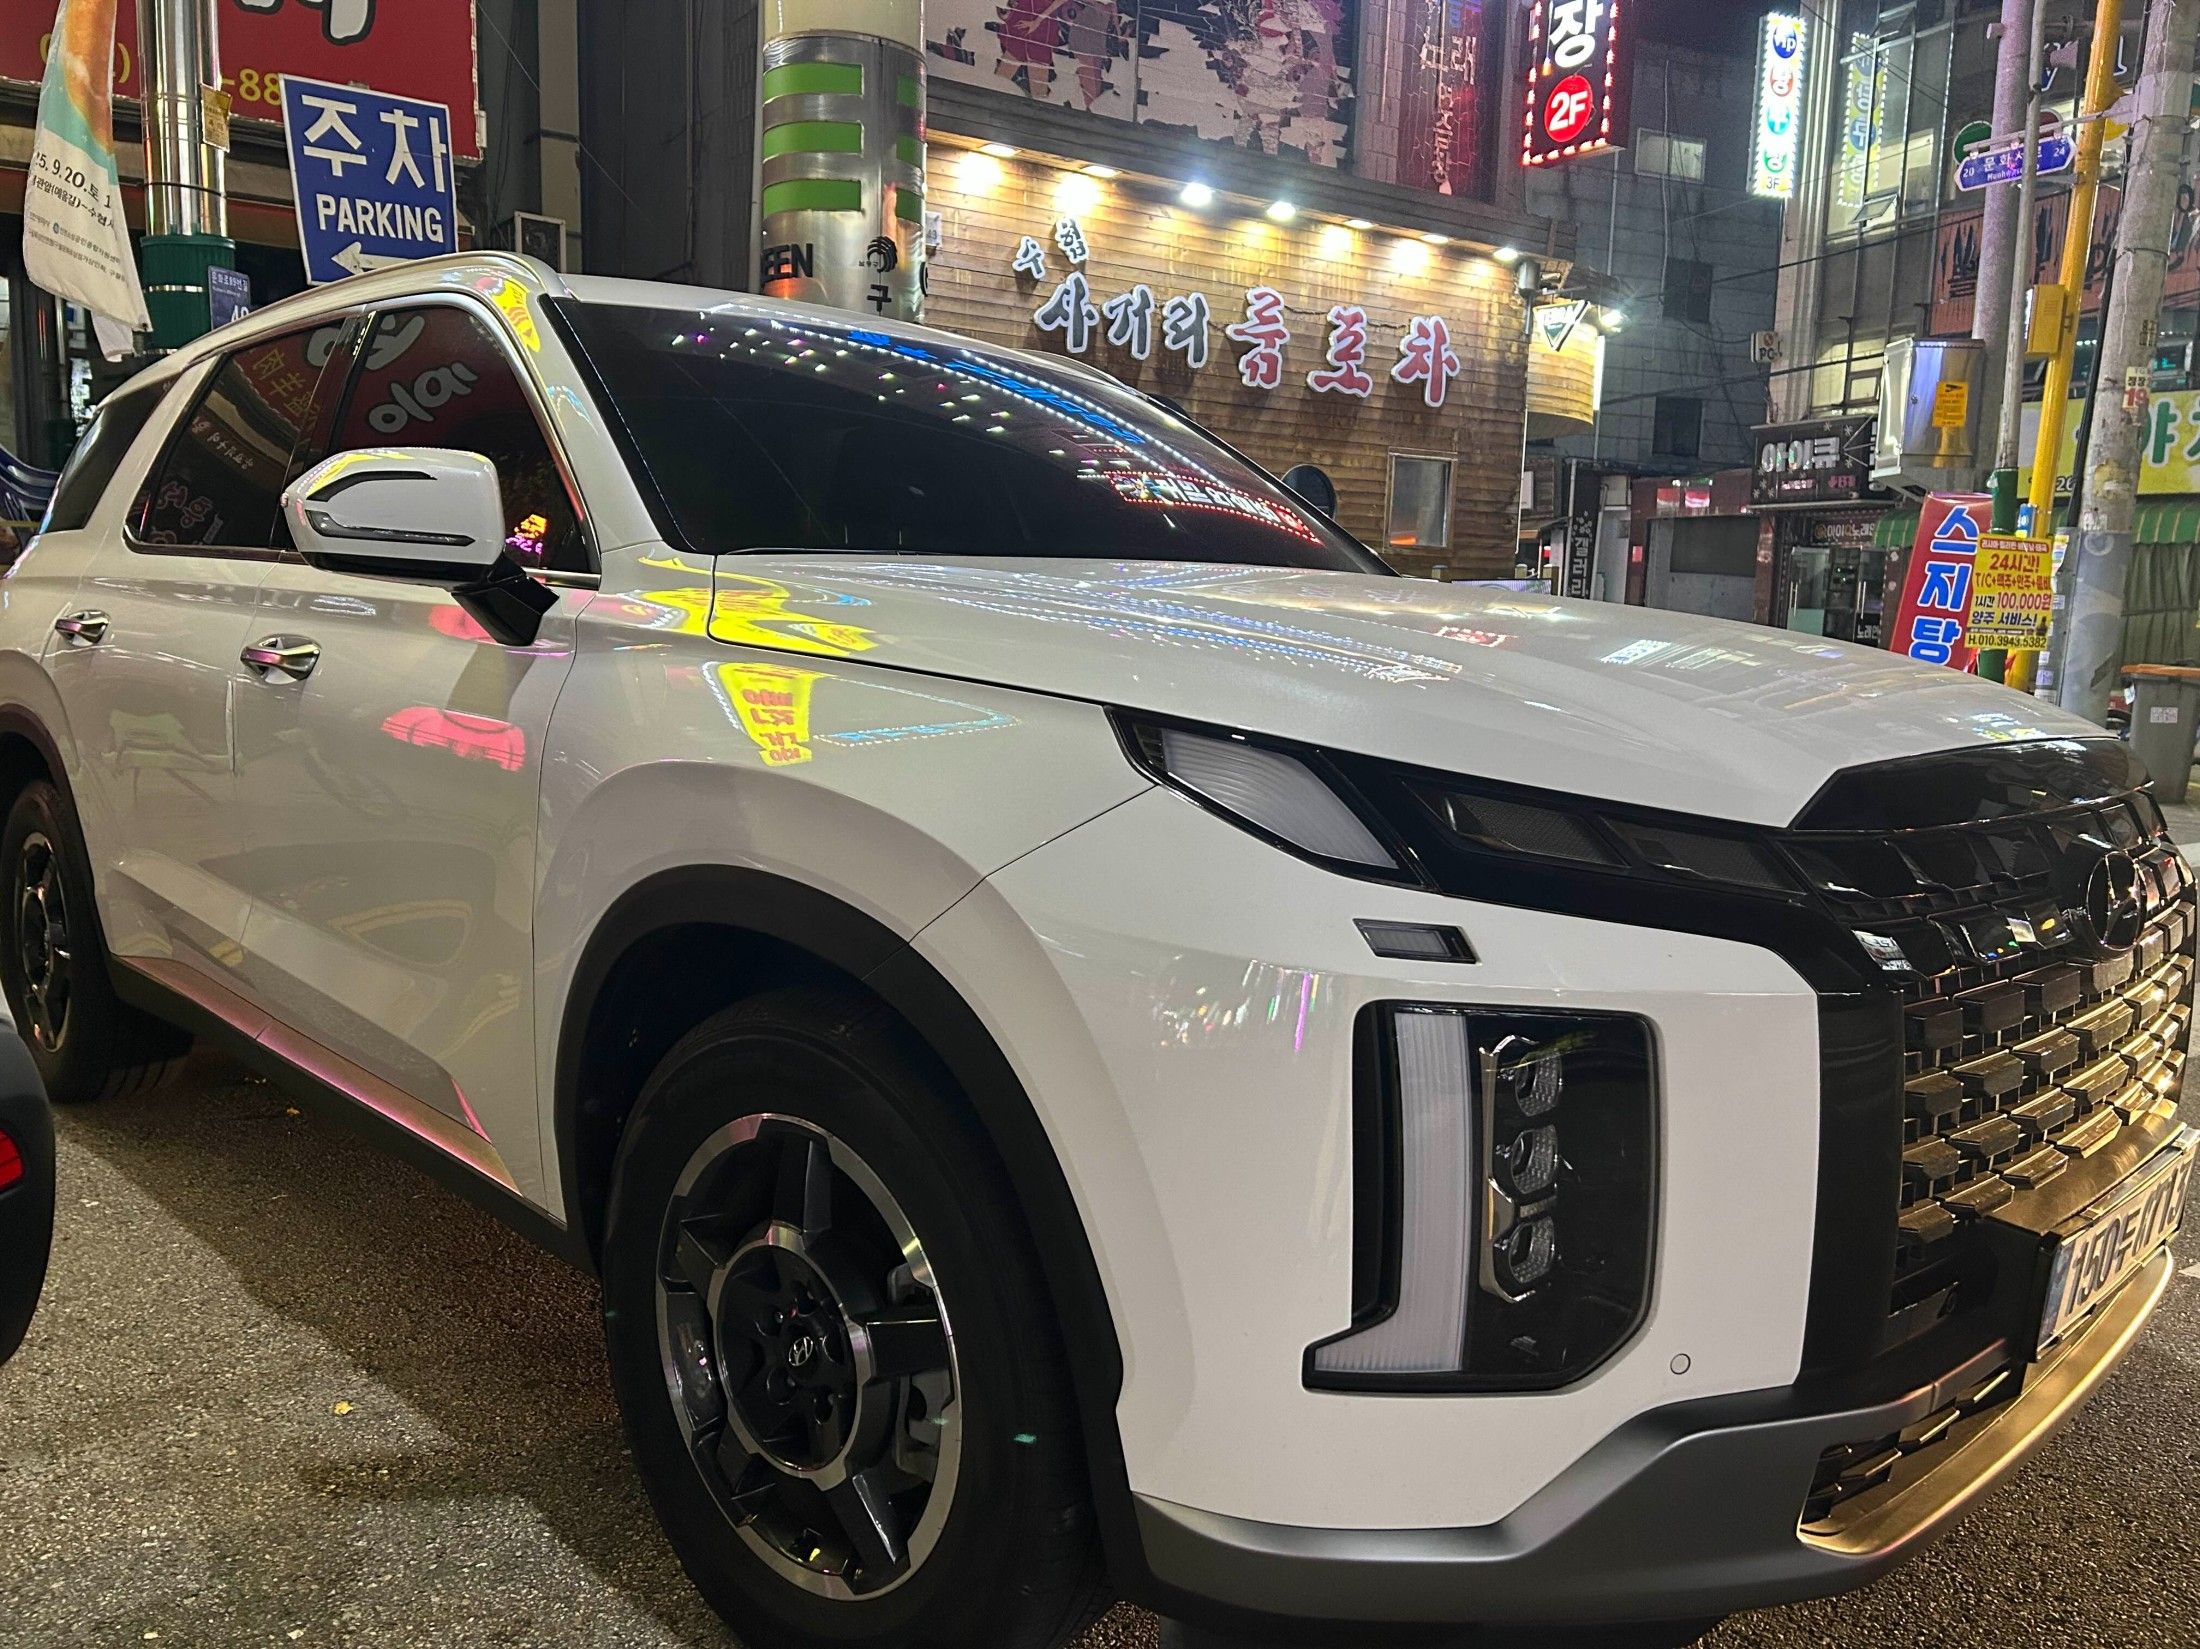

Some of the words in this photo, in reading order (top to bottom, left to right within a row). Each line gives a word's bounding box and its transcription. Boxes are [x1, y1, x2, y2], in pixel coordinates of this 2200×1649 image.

[1549, 91, 1588, 131] 2F
[302, 95, 448, 193] 주차
[1963, 167, 1974, 178] 20
[2054, 147, 2065, 157] 24
[1766, 176, 1781, 190] 3F
[316, 193, 444, 243] PARKING
[866, 284, 892, 313] 구
[1034, 271, 1210, 368] 사거리
[1762, 436, 1840, 473] 아이큐
[1571, 536, 1589, 597] 갤러리
[1989, 553, 2040, 573] 24시간!
[1909, 506, 1980, 666] 스지탕
[1975, 595, 1995, 608] 1시간
[1997, 591, 2051, 611] 100,000원
[1972, 611, 1995, 625] 양주
[1997, 612, 2038, 627] 서비스!
